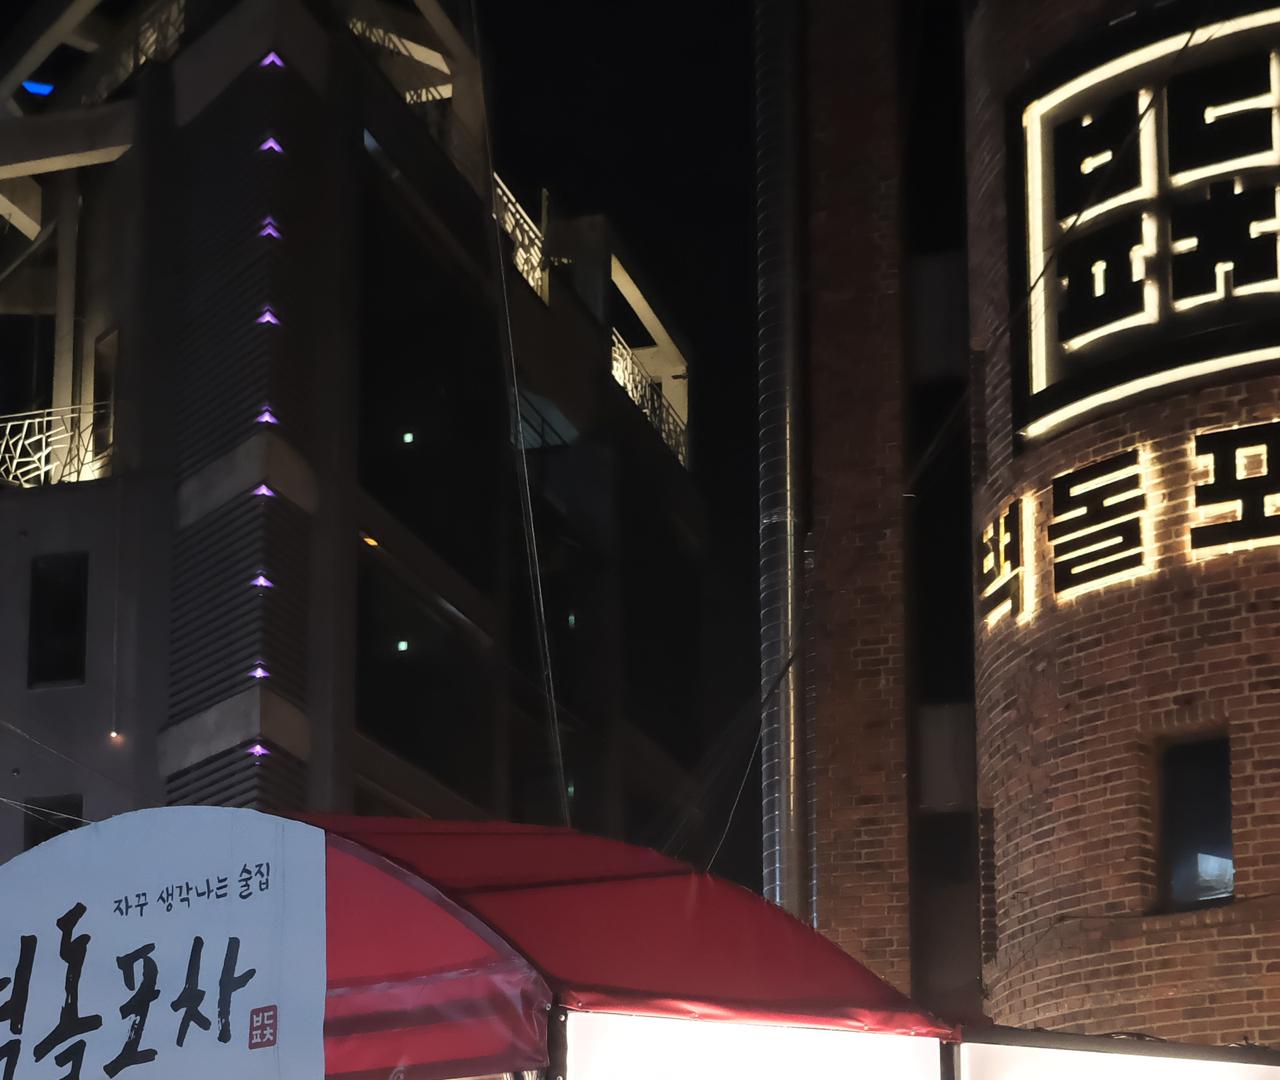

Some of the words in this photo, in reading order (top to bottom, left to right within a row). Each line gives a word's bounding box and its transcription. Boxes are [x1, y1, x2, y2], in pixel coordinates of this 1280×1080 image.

[113, 893, 148, 917] 자꾸
[157, 875, 229, 913] 생각나는
[238, 862, 272, 900] 술집
